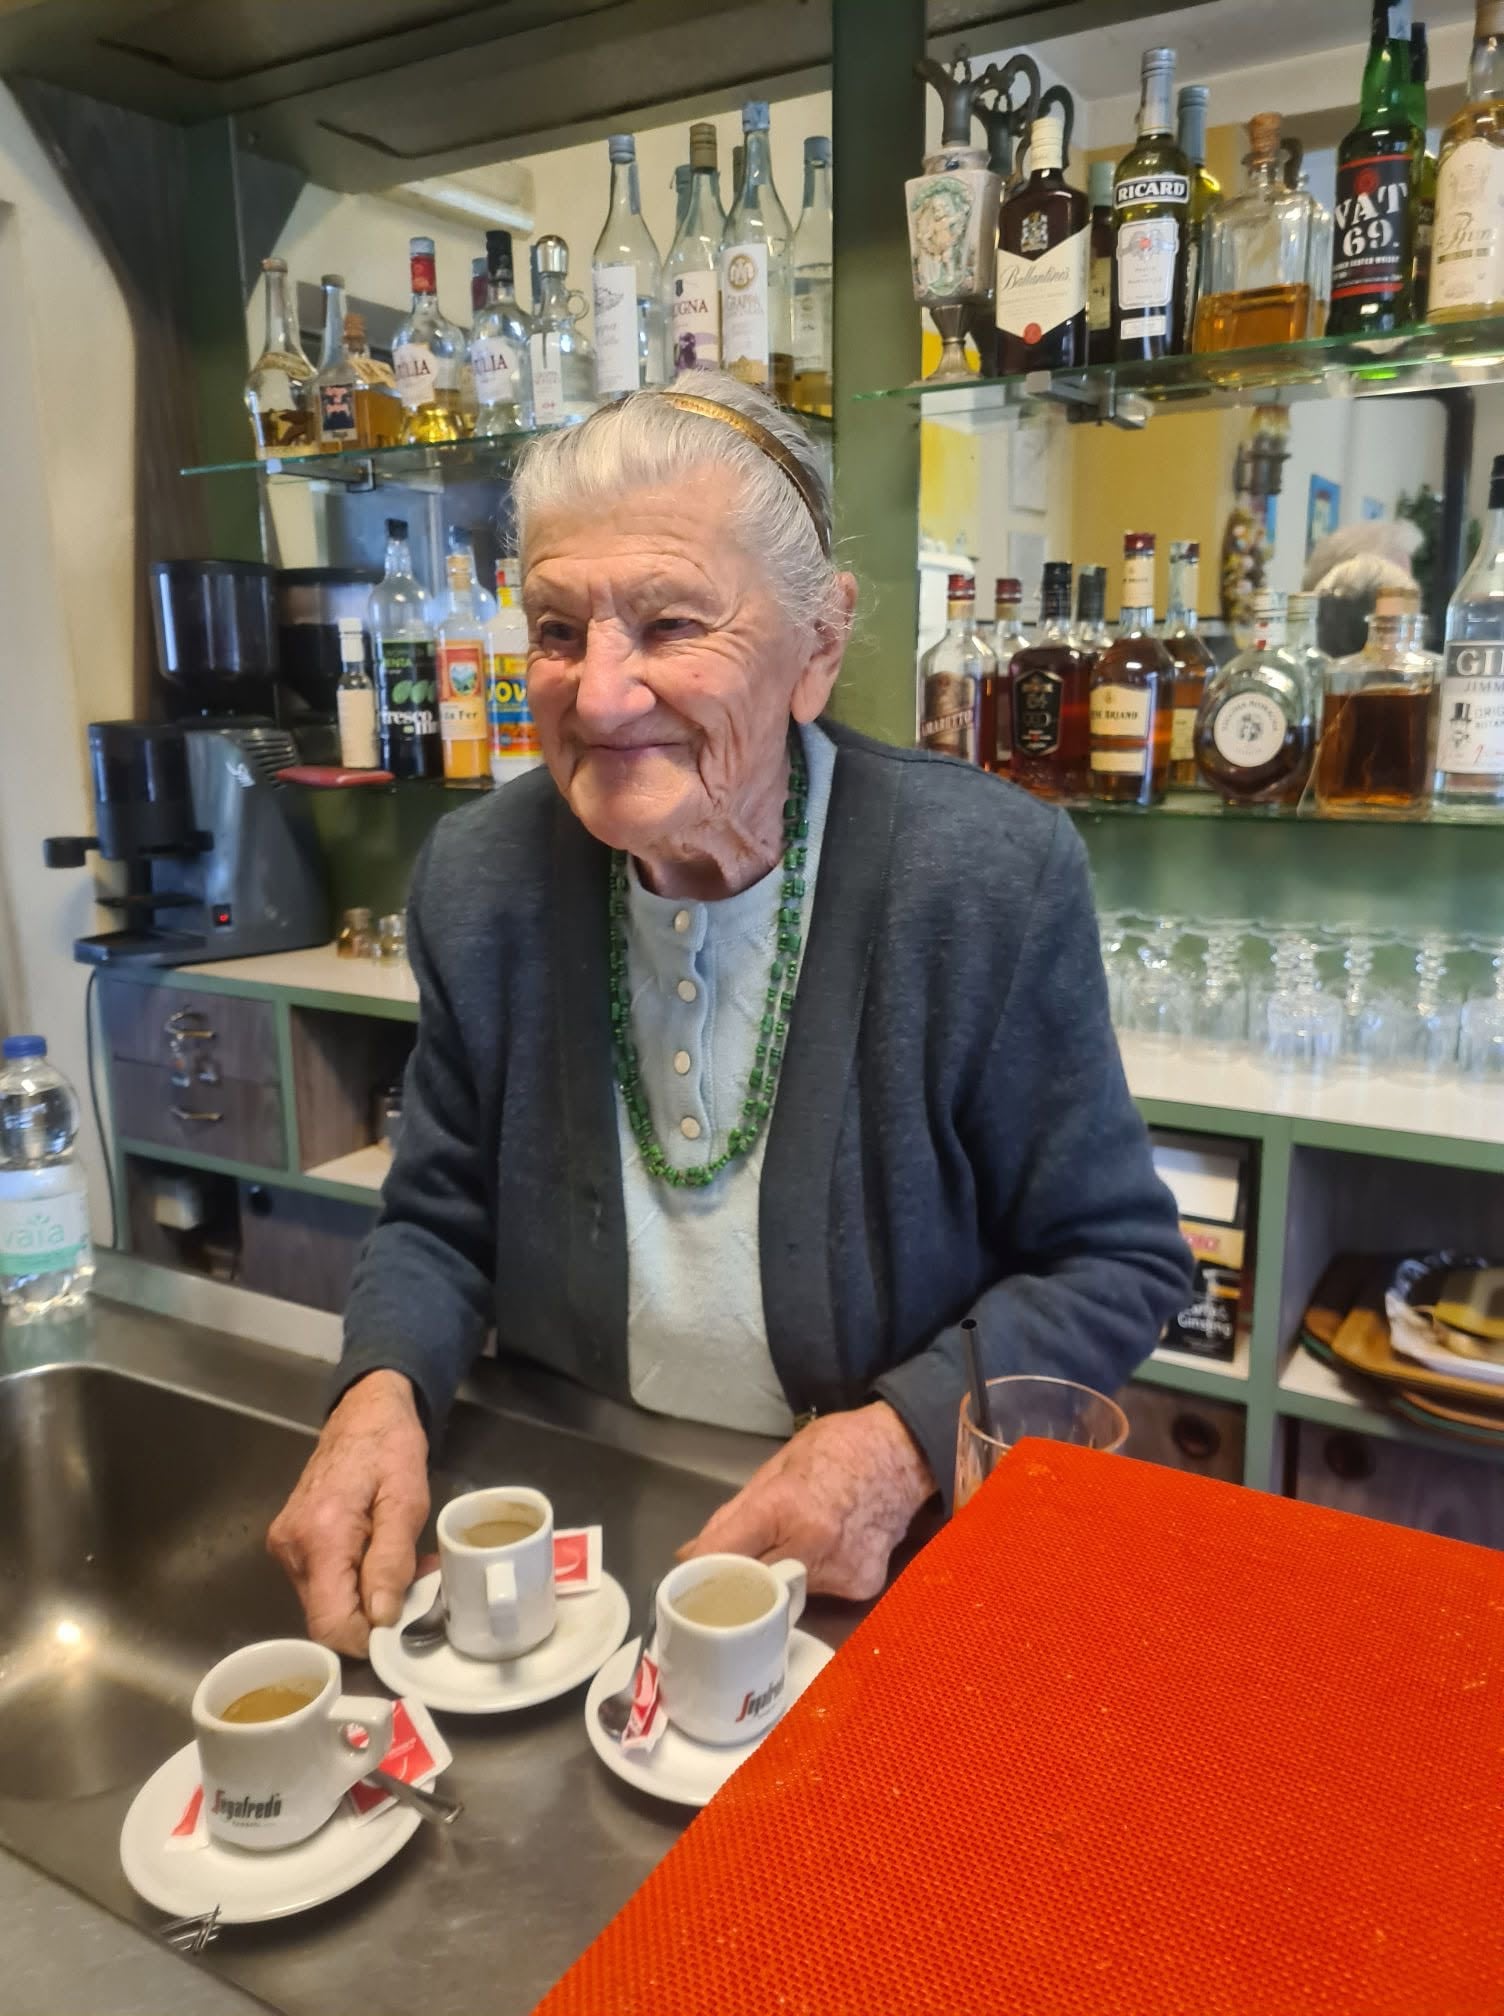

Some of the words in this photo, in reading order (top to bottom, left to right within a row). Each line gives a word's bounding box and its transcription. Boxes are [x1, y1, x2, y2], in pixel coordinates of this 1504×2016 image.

[1118, 181, 1186, 202] RICARD
[1335, 183, 1408, 230] VAT
[1456, 651, 1504, 676] GI
